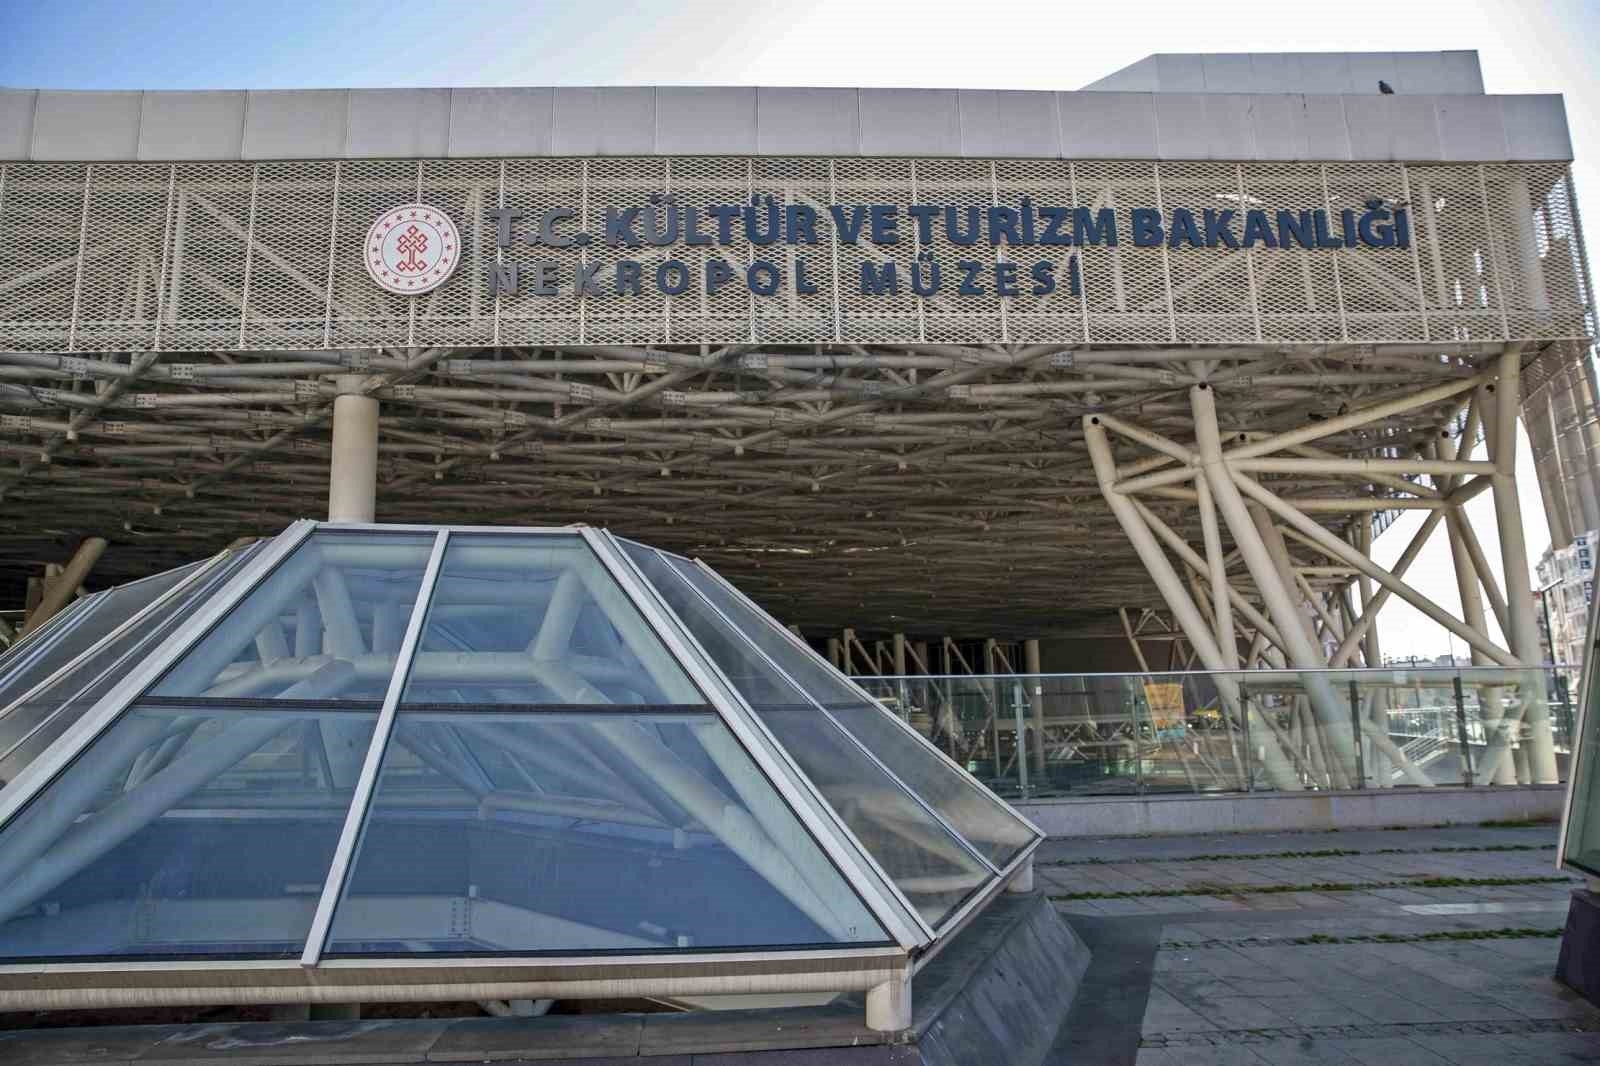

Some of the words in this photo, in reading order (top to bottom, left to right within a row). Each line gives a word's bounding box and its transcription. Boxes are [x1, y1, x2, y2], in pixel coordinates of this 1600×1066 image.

[605, 192, 818, 247] KÜLTÜR
[829, 204, 899, 245] VE
[908, 198, 1118, 247] TURİZM
[1131, 195, 1410, 249] BAKANLIĞI
[487, 259, 818, 297] NEKROPOL
[860, 251, 1081, 297] MÜZESİ
